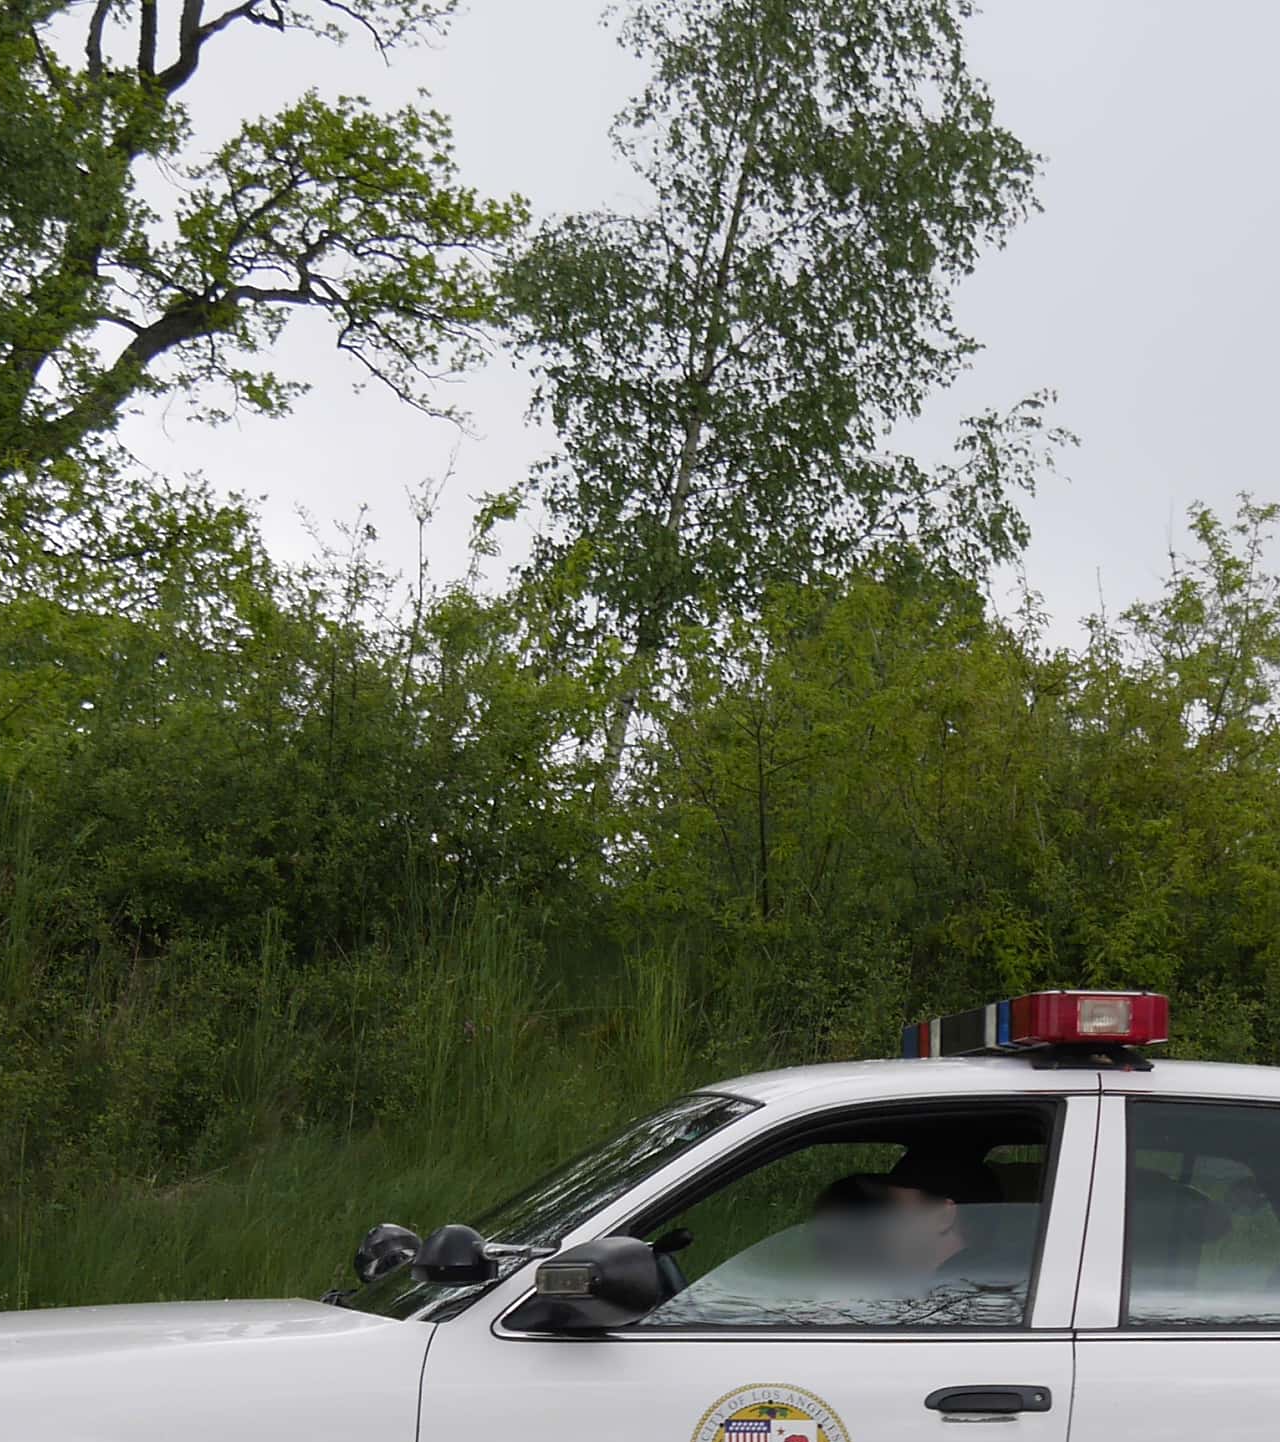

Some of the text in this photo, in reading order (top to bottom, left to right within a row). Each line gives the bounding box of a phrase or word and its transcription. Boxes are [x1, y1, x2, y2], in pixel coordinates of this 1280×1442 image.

[701, 1389, 842, 1442] CITY OF LOS ANGELES
